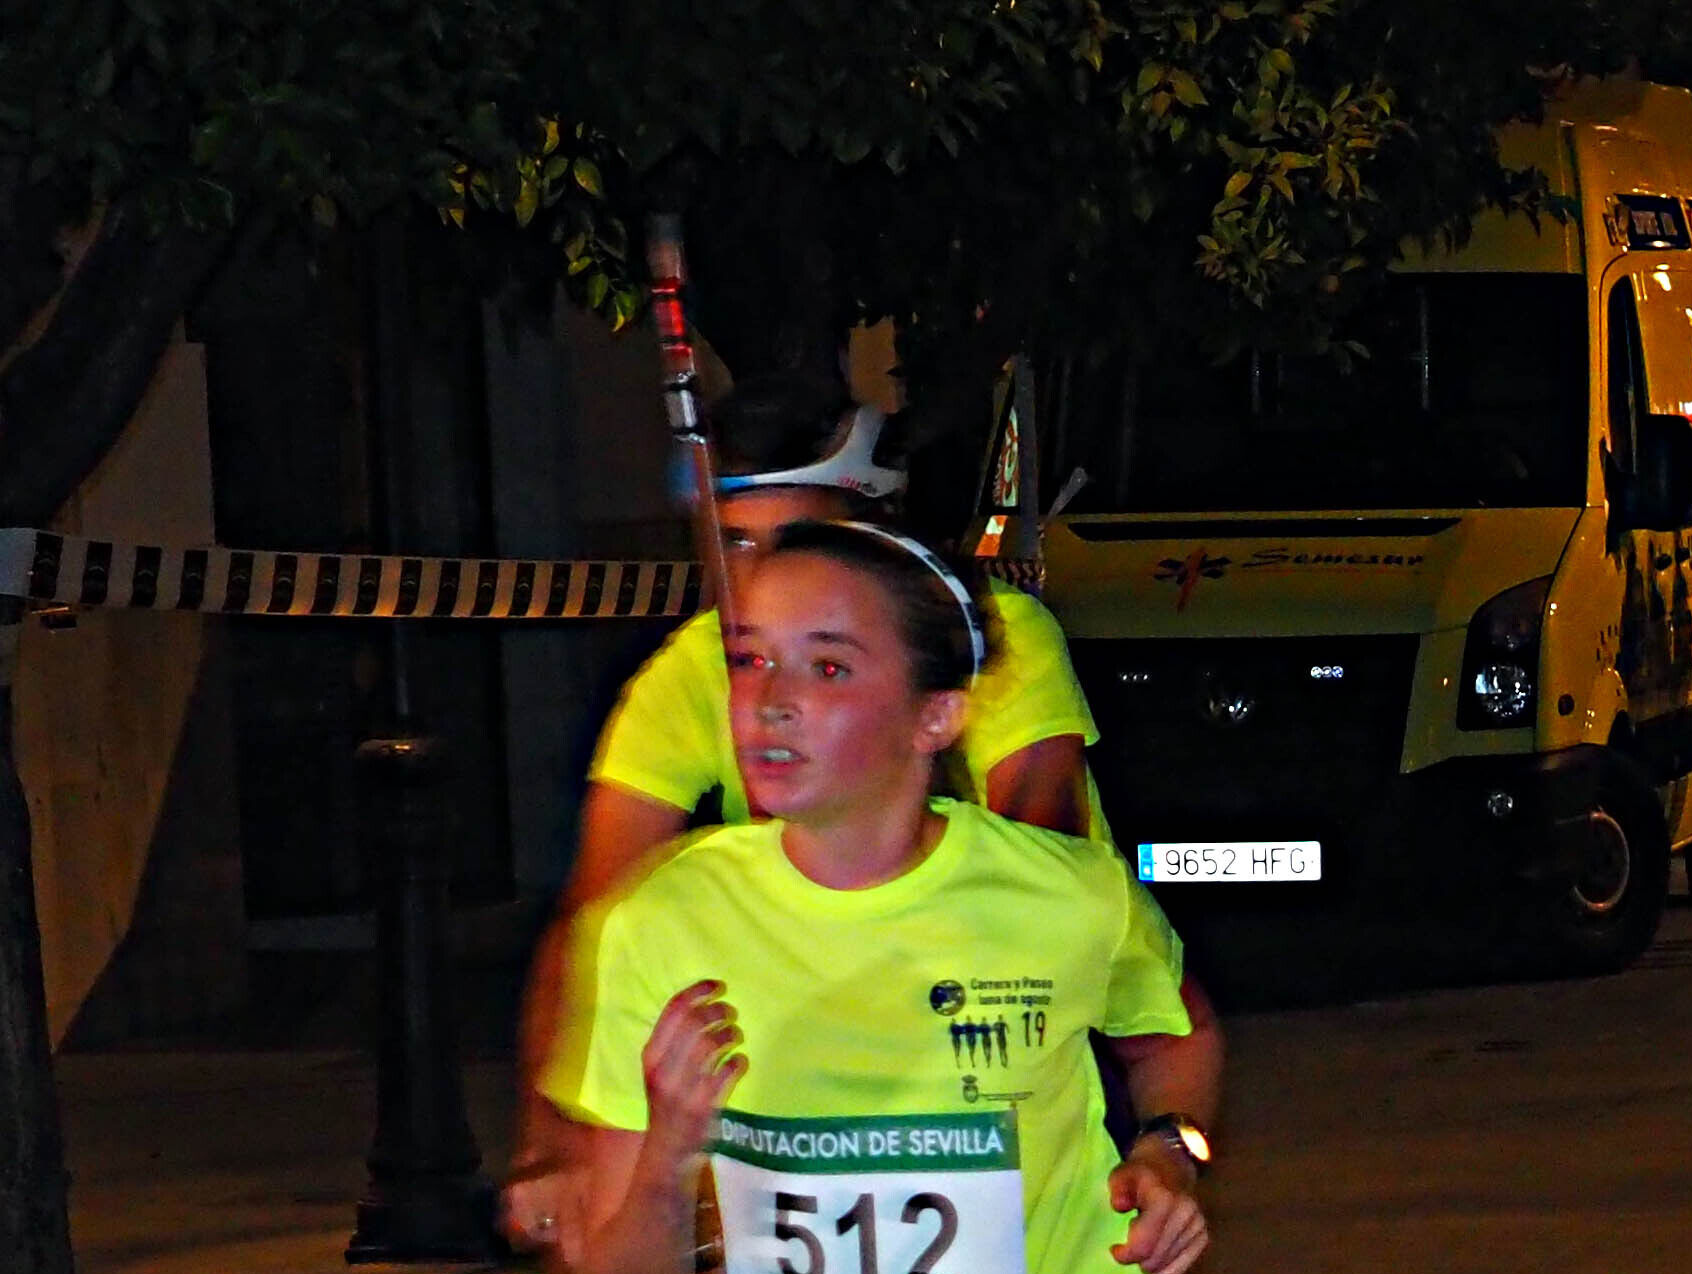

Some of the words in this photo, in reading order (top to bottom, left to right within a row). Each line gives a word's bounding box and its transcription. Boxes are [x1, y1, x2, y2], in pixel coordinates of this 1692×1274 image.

[1165, 849, 1237, 876] 9652
[1251, 847, 1306, 875] HFG
[1022, 1011, 1046, 1047] 19
[720, 1118, 861, 1159] DIPUTACION
[868, 1131, 900, 1156] DE
[908, 1126, 1004, 1157] SEVILLA
